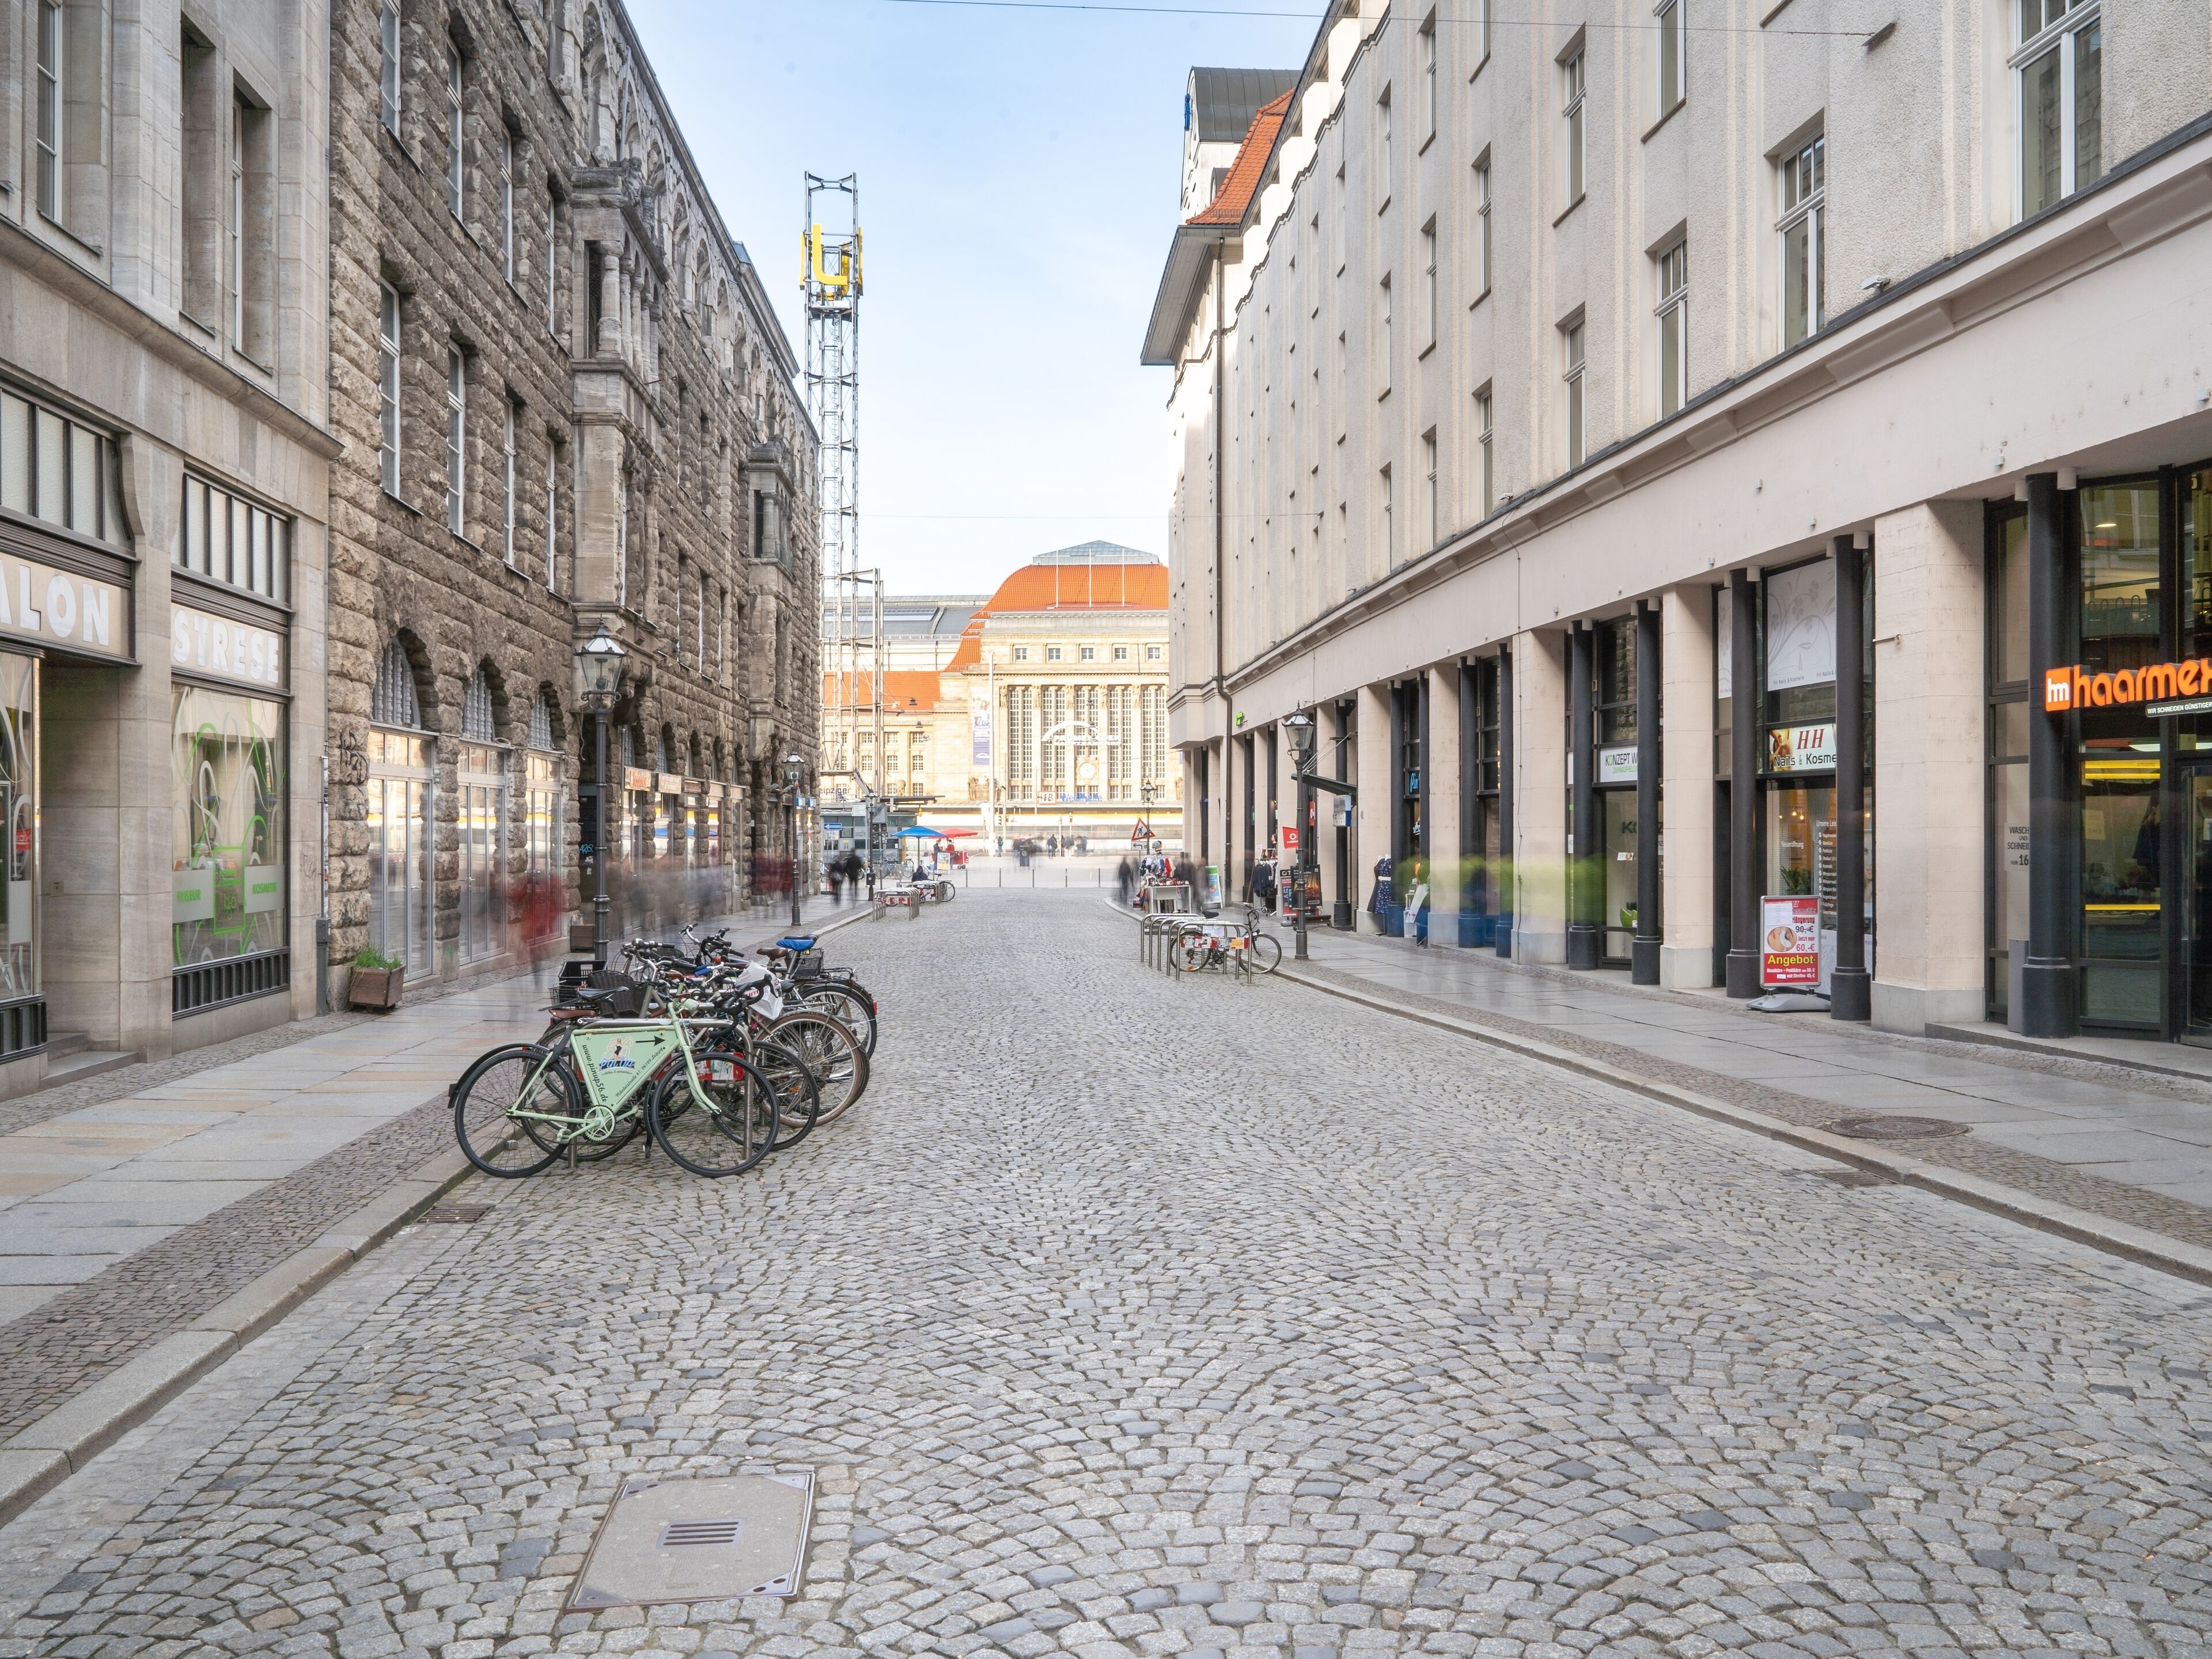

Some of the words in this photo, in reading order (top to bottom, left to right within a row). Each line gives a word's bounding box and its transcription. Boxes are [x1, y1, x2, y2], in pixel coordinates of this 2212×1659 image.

[173, 609, 279, 683] STRESE
[2157, 704, 2184, 713] SCHNEIDEN
[1605, 753, 1630, 766] KONZEPT
[1774, 755, 1796, 767] Nails
[1798, 754, 1802, 766] &
[252, 882, 277, 895] KOSMETIK
[177, 889, 201, 903] FRISEUR
[641, 1058, 652, 1070] 04109
[652, 1047, 664, 1060] Leipzig
[582, 1044, 608, 1103] www.pinup56.de
